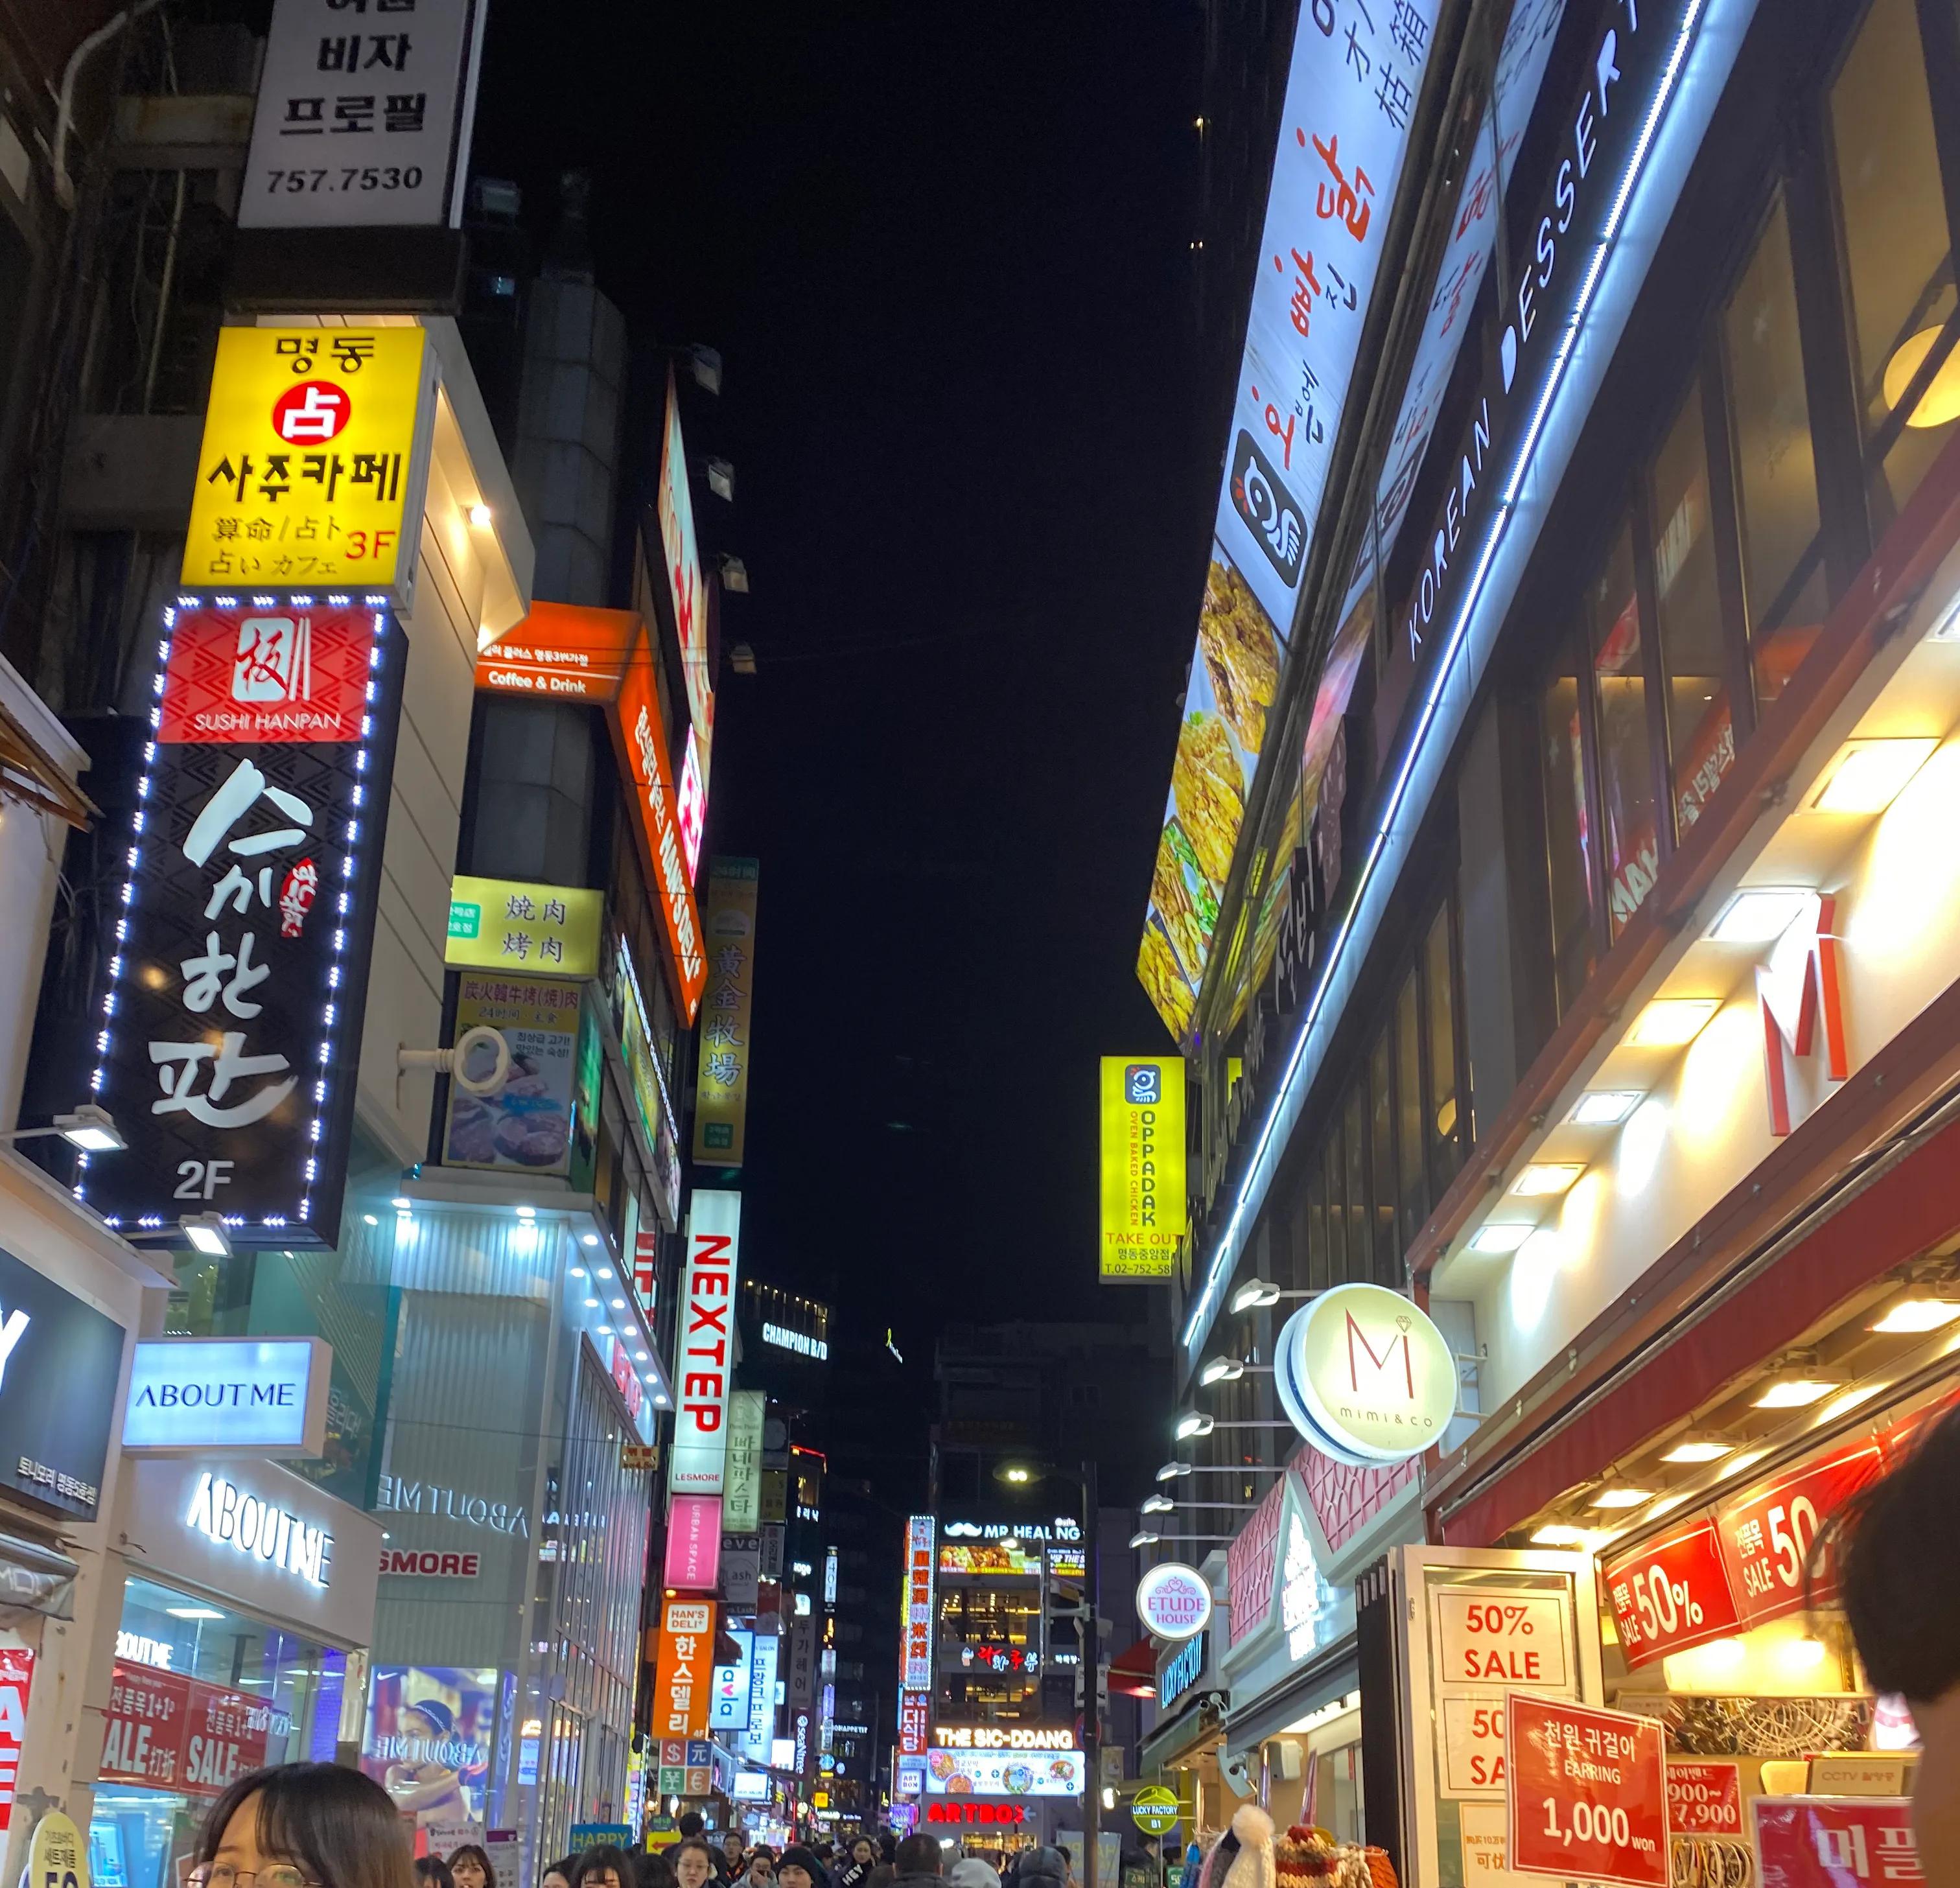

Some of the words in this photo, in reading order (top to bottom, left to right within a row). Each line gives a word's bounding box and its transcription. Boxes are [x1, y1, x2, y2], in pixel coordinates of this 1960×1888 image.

[316, 32, 413, 73] 비자
[279, 93, 427, 135] 프로필
[267, 166, 425, 194] 757.7530
[275, 337, 375, 374] 명동
[282, 386, 341, 439] 占
[207, 452, 402, 503] 사주카페
[345, 530, 396, 560] 3F
[1409, 397, 1489, 662] KOREAN
[272, 554, 338, 576] カフェ
[488, 670, 533, 688] Coffee
[535, 675, 547, 690] &
[550, 677, 587, 693] Drink
[194, 713, 253, 730] SUSHI
[255, 712, 341, 730] HANPAN
[502, 932, 563, 963] 烤肉
[1130, 1111, 1138, 1139] OVEN
[1130, 1143, 1138, 1176] BAKED
[1141, 1110, 1156, 1227] OPPADAK
[173, 1160, 235, 1200] 2F
[1130, 1180, 1138, 1226] CHICKEN
[1106, 1233, 1143, 1245] TAKE
[1150, 1233, 1181, 1246] OUT
[683, 1235, 732, 1432] NEXTEP
[763, 1322, 810, 1356] CHAMPION
[810, 1336, 828, 1361] B/D
[675, 1473, 720, 1482] LESMORE
[690, 1504, 701, 1541] URBAN
[1014, 1525, 1080, 1541] HEALNG
[1735, 1519, 1765, 1558] 전품목
[723, 1538, 758, 1549] eve
[686, 1543, 698, 1581] SPACE
[1743, 1558, 1775, 1598] SALE
[671, 1610, 705, 1619] HAN'S
[1147, 1597, 1204, 1612] ETUDE
[1633, 1564, 1704, 1640] 50%
[1156, 1613, 1196, 1625] HOUSE
[1465, 1605, 1534, 1636] 50%
[1620, 1607, 1642, 1648] SALE
[1464, 1649, 1541, 1680] SALE
[111, 1685, 146, 1718] 전품목
[668, 1635, 697, 1735] 한스델리
[102, 1719, 153, 1774] ALE
[694, 1729, 705, 1738] 4F
[936, 1727, 972, 1747] THE
[974, 1728, 1073, 1749] SIC-DDANG
[1544, 1719, 1582, 1753] 천원
[1585, 1728, 1636, 1763] 귀걸이
[186, 1735, 240, 1787] SALE
[691, 1743, 707, 1761] 元
[1565, 1758, 1622, 1785] EARRING
[1822, 1771, 1858, 1781] CCTV
[1132, 1806, 1151, 1815] LUCKY
[1151, 1806, 1178, 1815] FACTORY
[1543, 1796, 1629, 1847] 1,000
[1631, 1835, 1656, 1852] won
[573, 1834, 628, 1847] HAPPY
